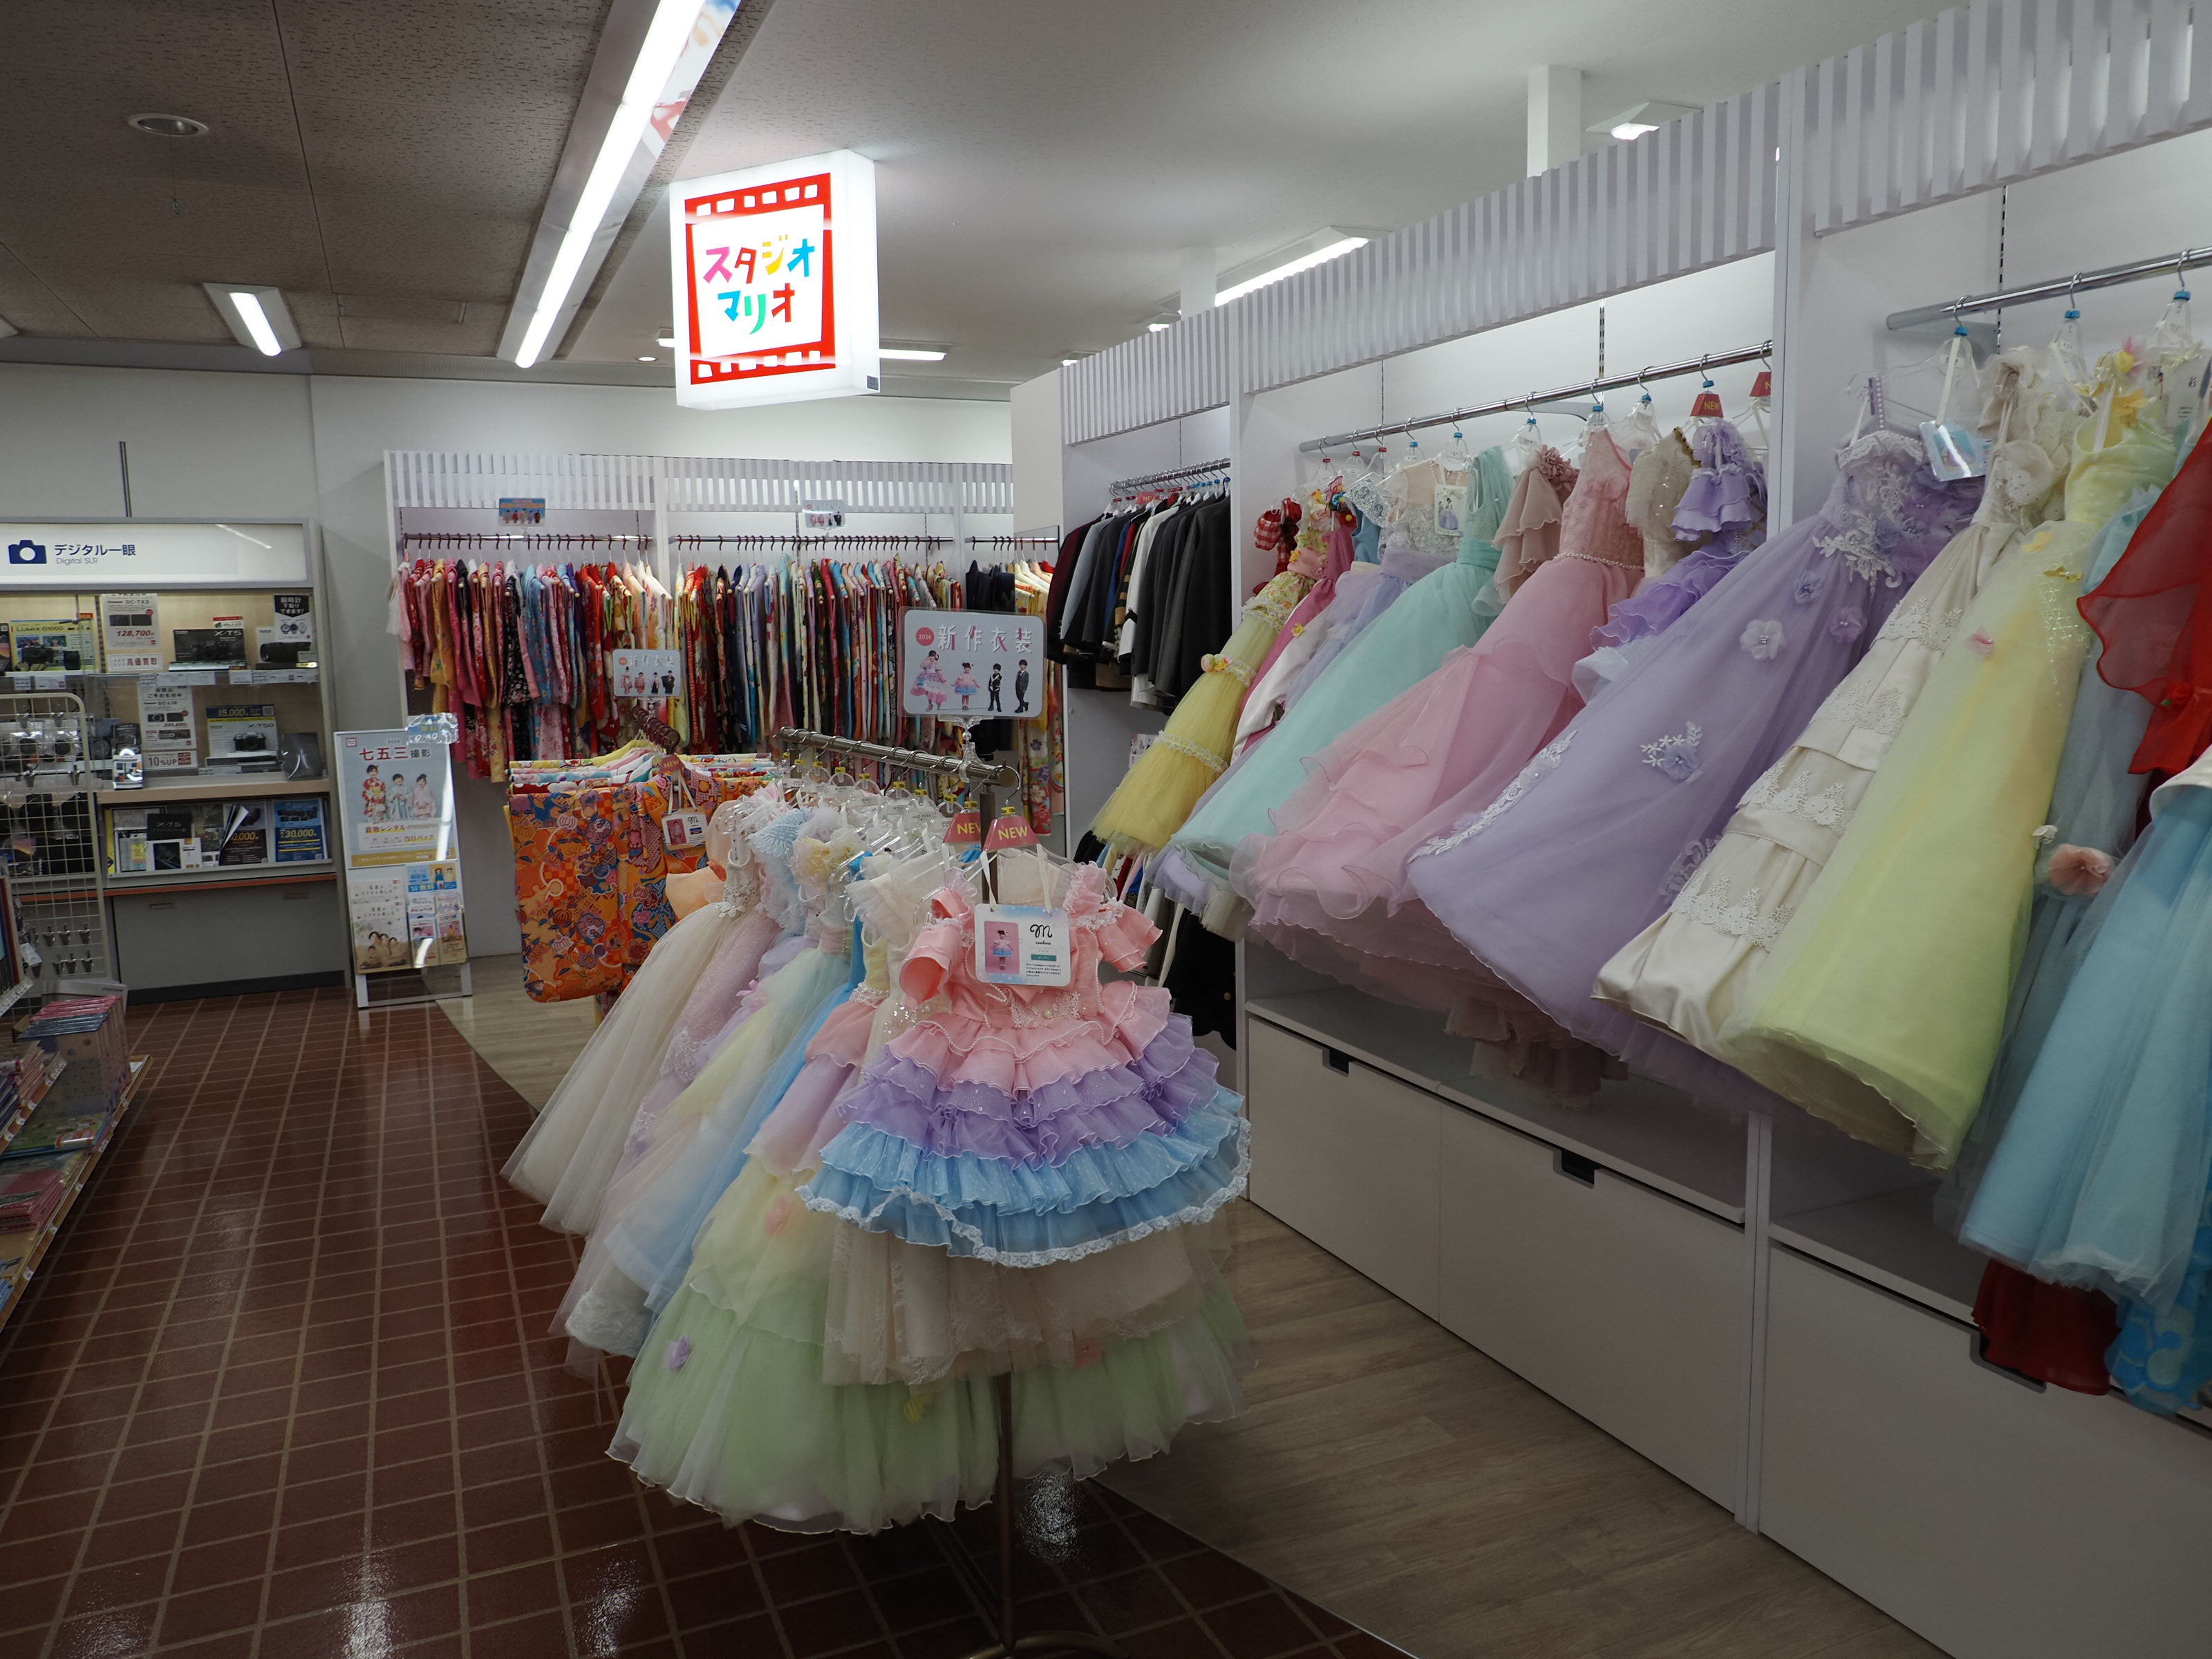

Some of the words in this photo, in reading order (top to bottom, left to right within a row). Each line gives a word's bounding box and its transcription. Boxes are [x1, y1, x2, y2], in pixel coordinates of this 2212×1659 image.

[703, 234, 815, 284] スタジオ
[718, 283, 795, 335] マリオ
[1704, 402, 1721, 411] NEW
[54, 544, 136, 556] デジタル一眼
[56, 557, 82, 565] Digital
[937, 624, 1033, 654] 新作衣装
[628, 655, 675, 668] 新作衣装
[359, 746, 431, 762] 七五三撮影
[664, 760, 679, 768] NEW
[998, 826, 1028, 841] NEW
